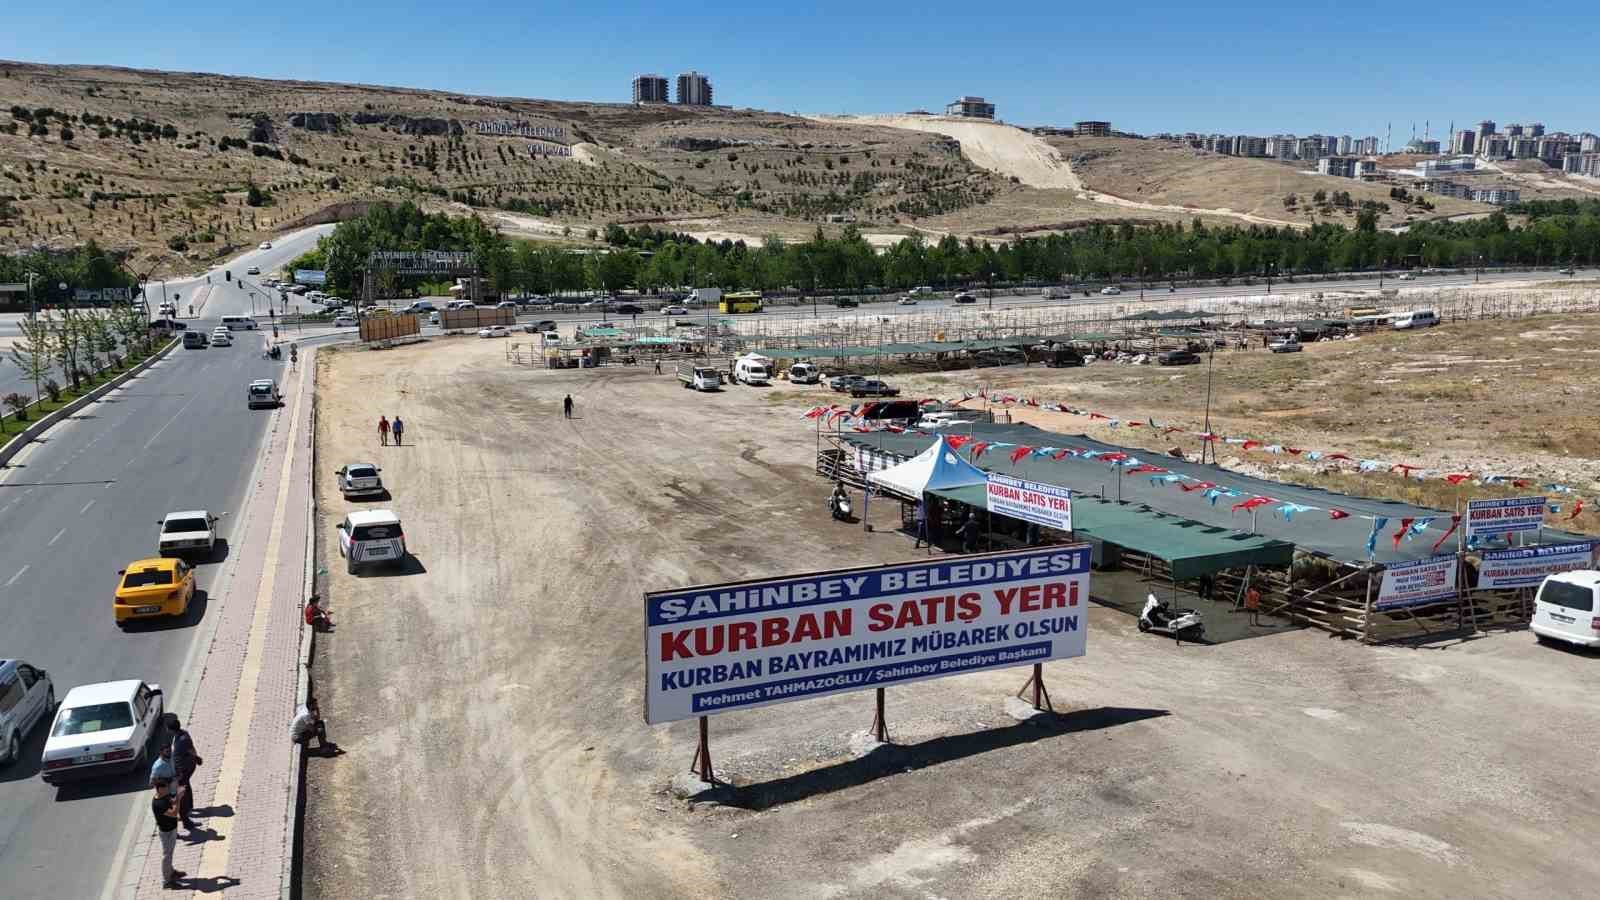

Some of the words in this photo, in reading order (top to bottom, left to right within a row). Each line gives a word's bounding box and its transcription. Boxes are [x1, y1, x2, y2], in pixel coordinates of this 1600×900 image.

[988, 484, 1020, 501] KURBAN
[1470, 508, 1502, 520] KURBAN
[660, 576, 868, 622] ŞAHİNBEY
[881, 553, 1081, 592] BELEDİYESİ
[660, 608, 852, 662] KURBAN
[868, 592, 982, 632] SATIŞ
[993, 581, 1079, 616] YERİ
[661, 659, 762, 691] KURBAN
[768, 639, 906, 675] BAYRAMIMIZ
[911, 623, 1010, 654] MÜBAREK
[1014, 615, 1078, 639] OLSUN
[699, 689, 761, 708] Mehmet
[764, 672, 863, 697] TAHMAZOĞLU
[876, 662, 938, 682] Şahinbey
[940, 654, 996, 671] Belediye
[998, 646, 1047, 662] Başkanı
